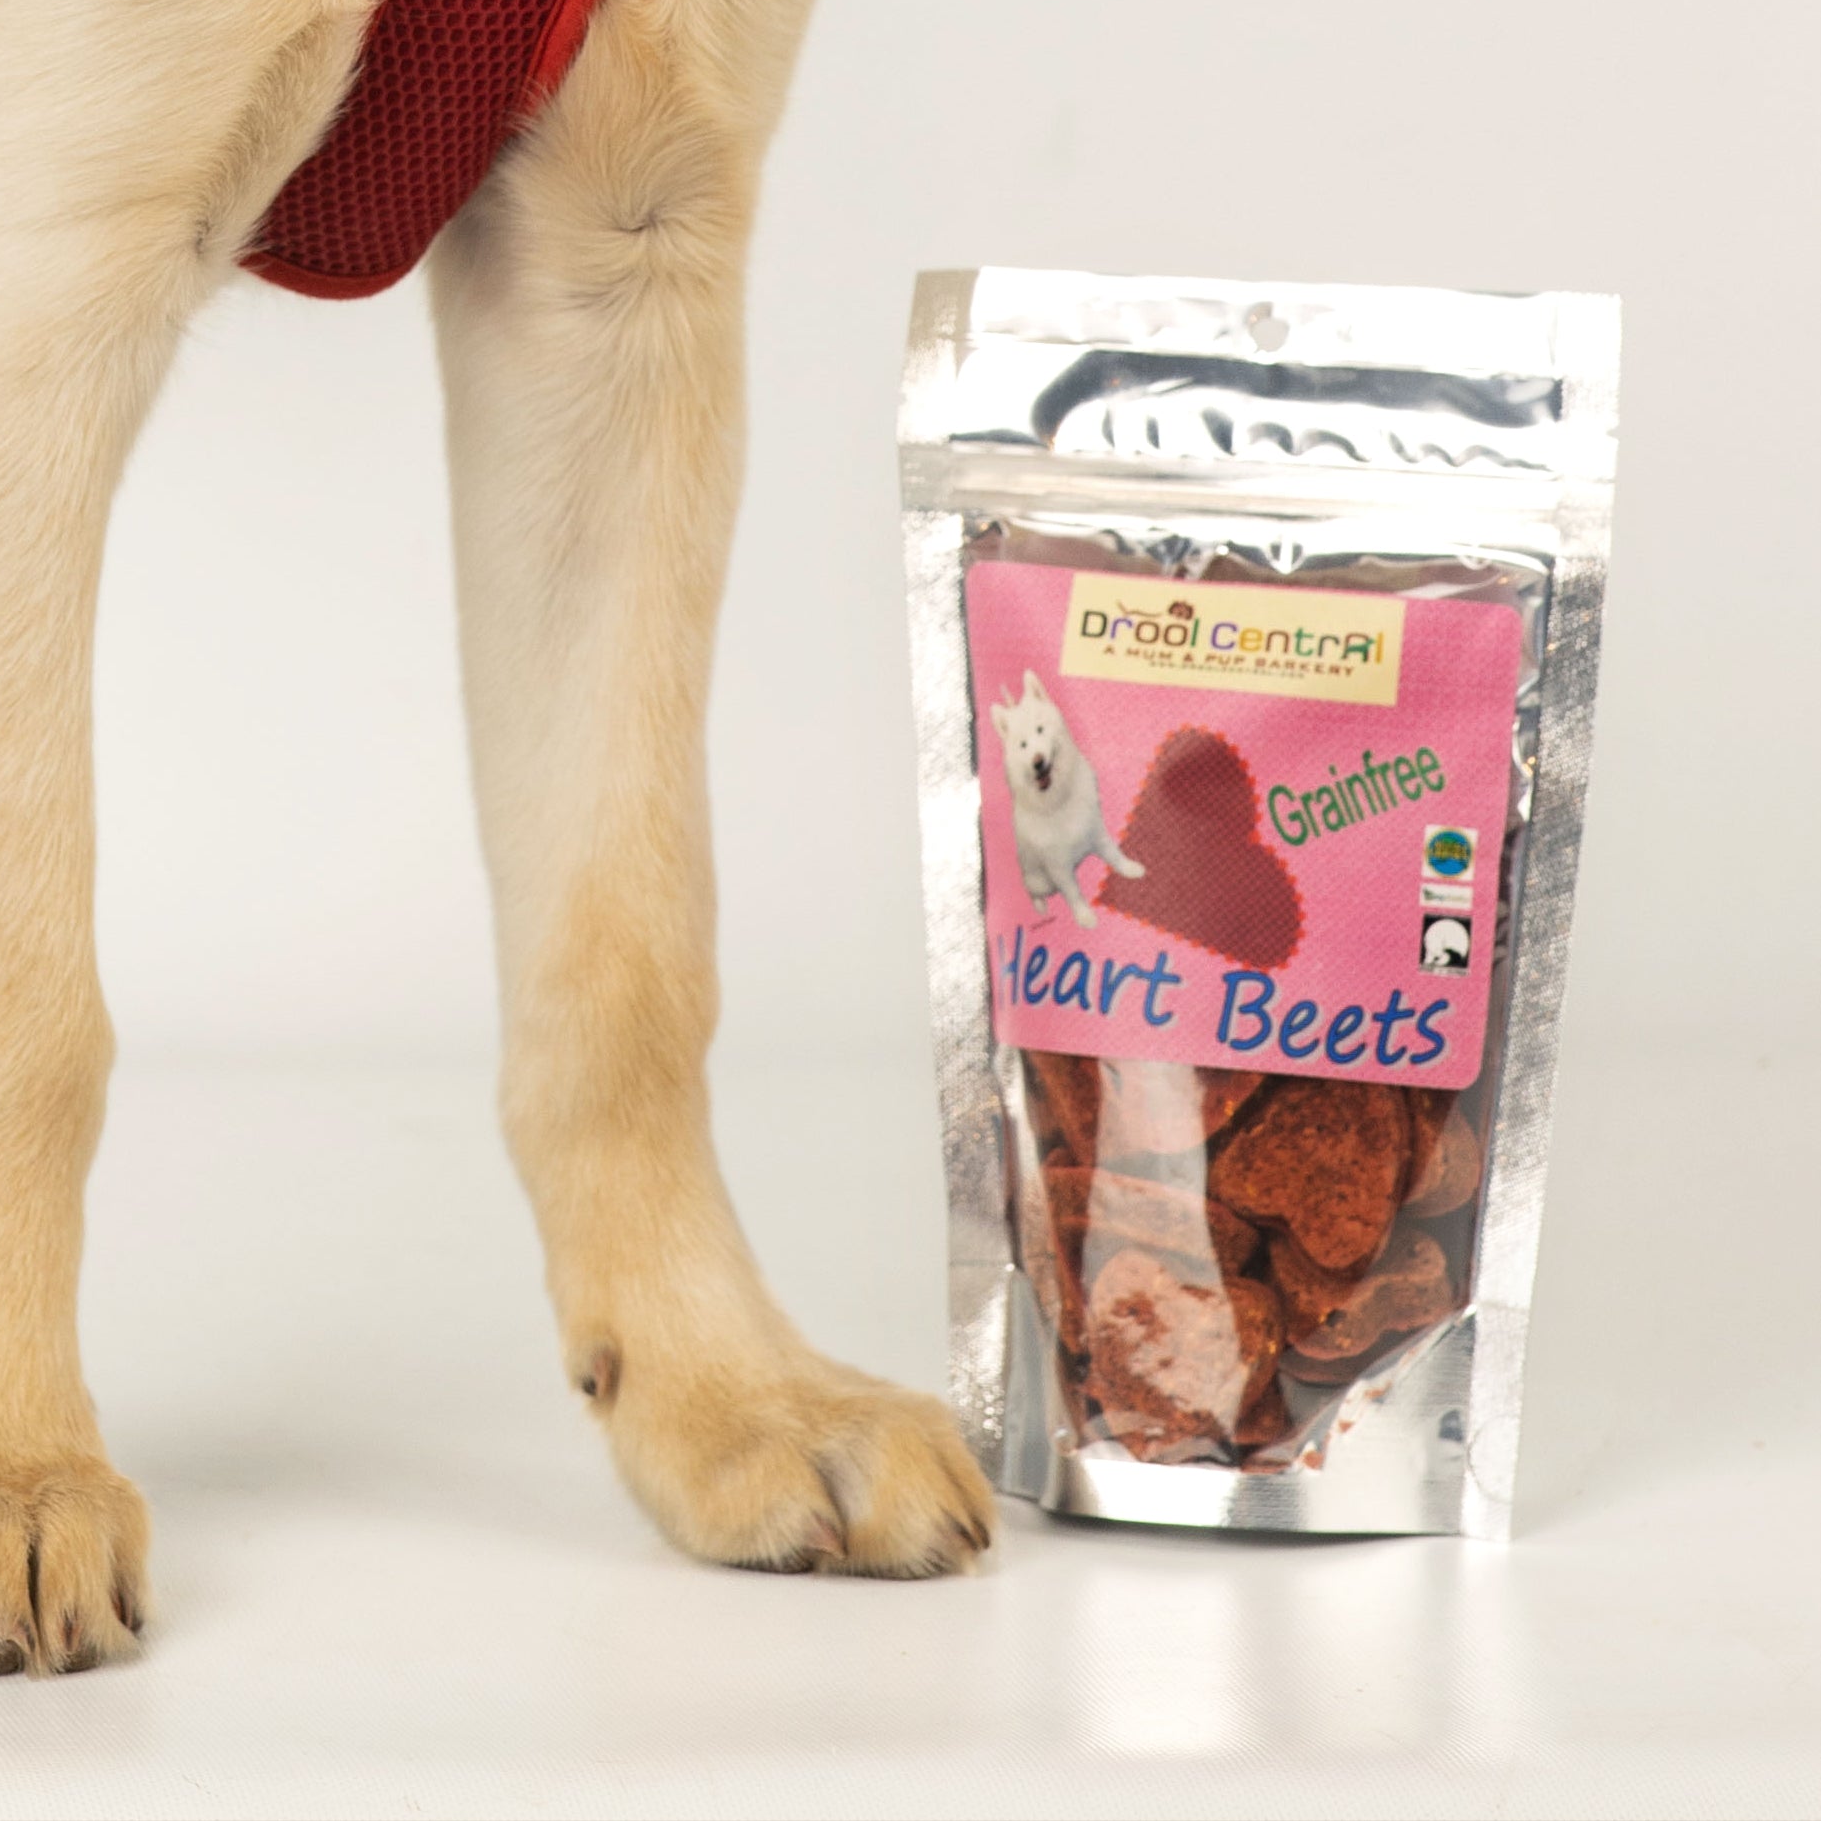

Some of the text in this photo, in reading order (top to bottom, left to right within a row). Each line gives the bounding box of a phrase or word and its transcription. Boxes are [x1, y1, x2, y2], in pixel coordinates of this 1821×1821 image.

[1080, 610, 1200, 648] Drool
[1103, 644, 1115, 655] A
[1125, 646, 1173, 661] MUM
[1205, 652, 1246, 666] PUP
[1267, 746, 1446, 847] Grainfree
[996, 924, 1450, 1065] Heart Beets
